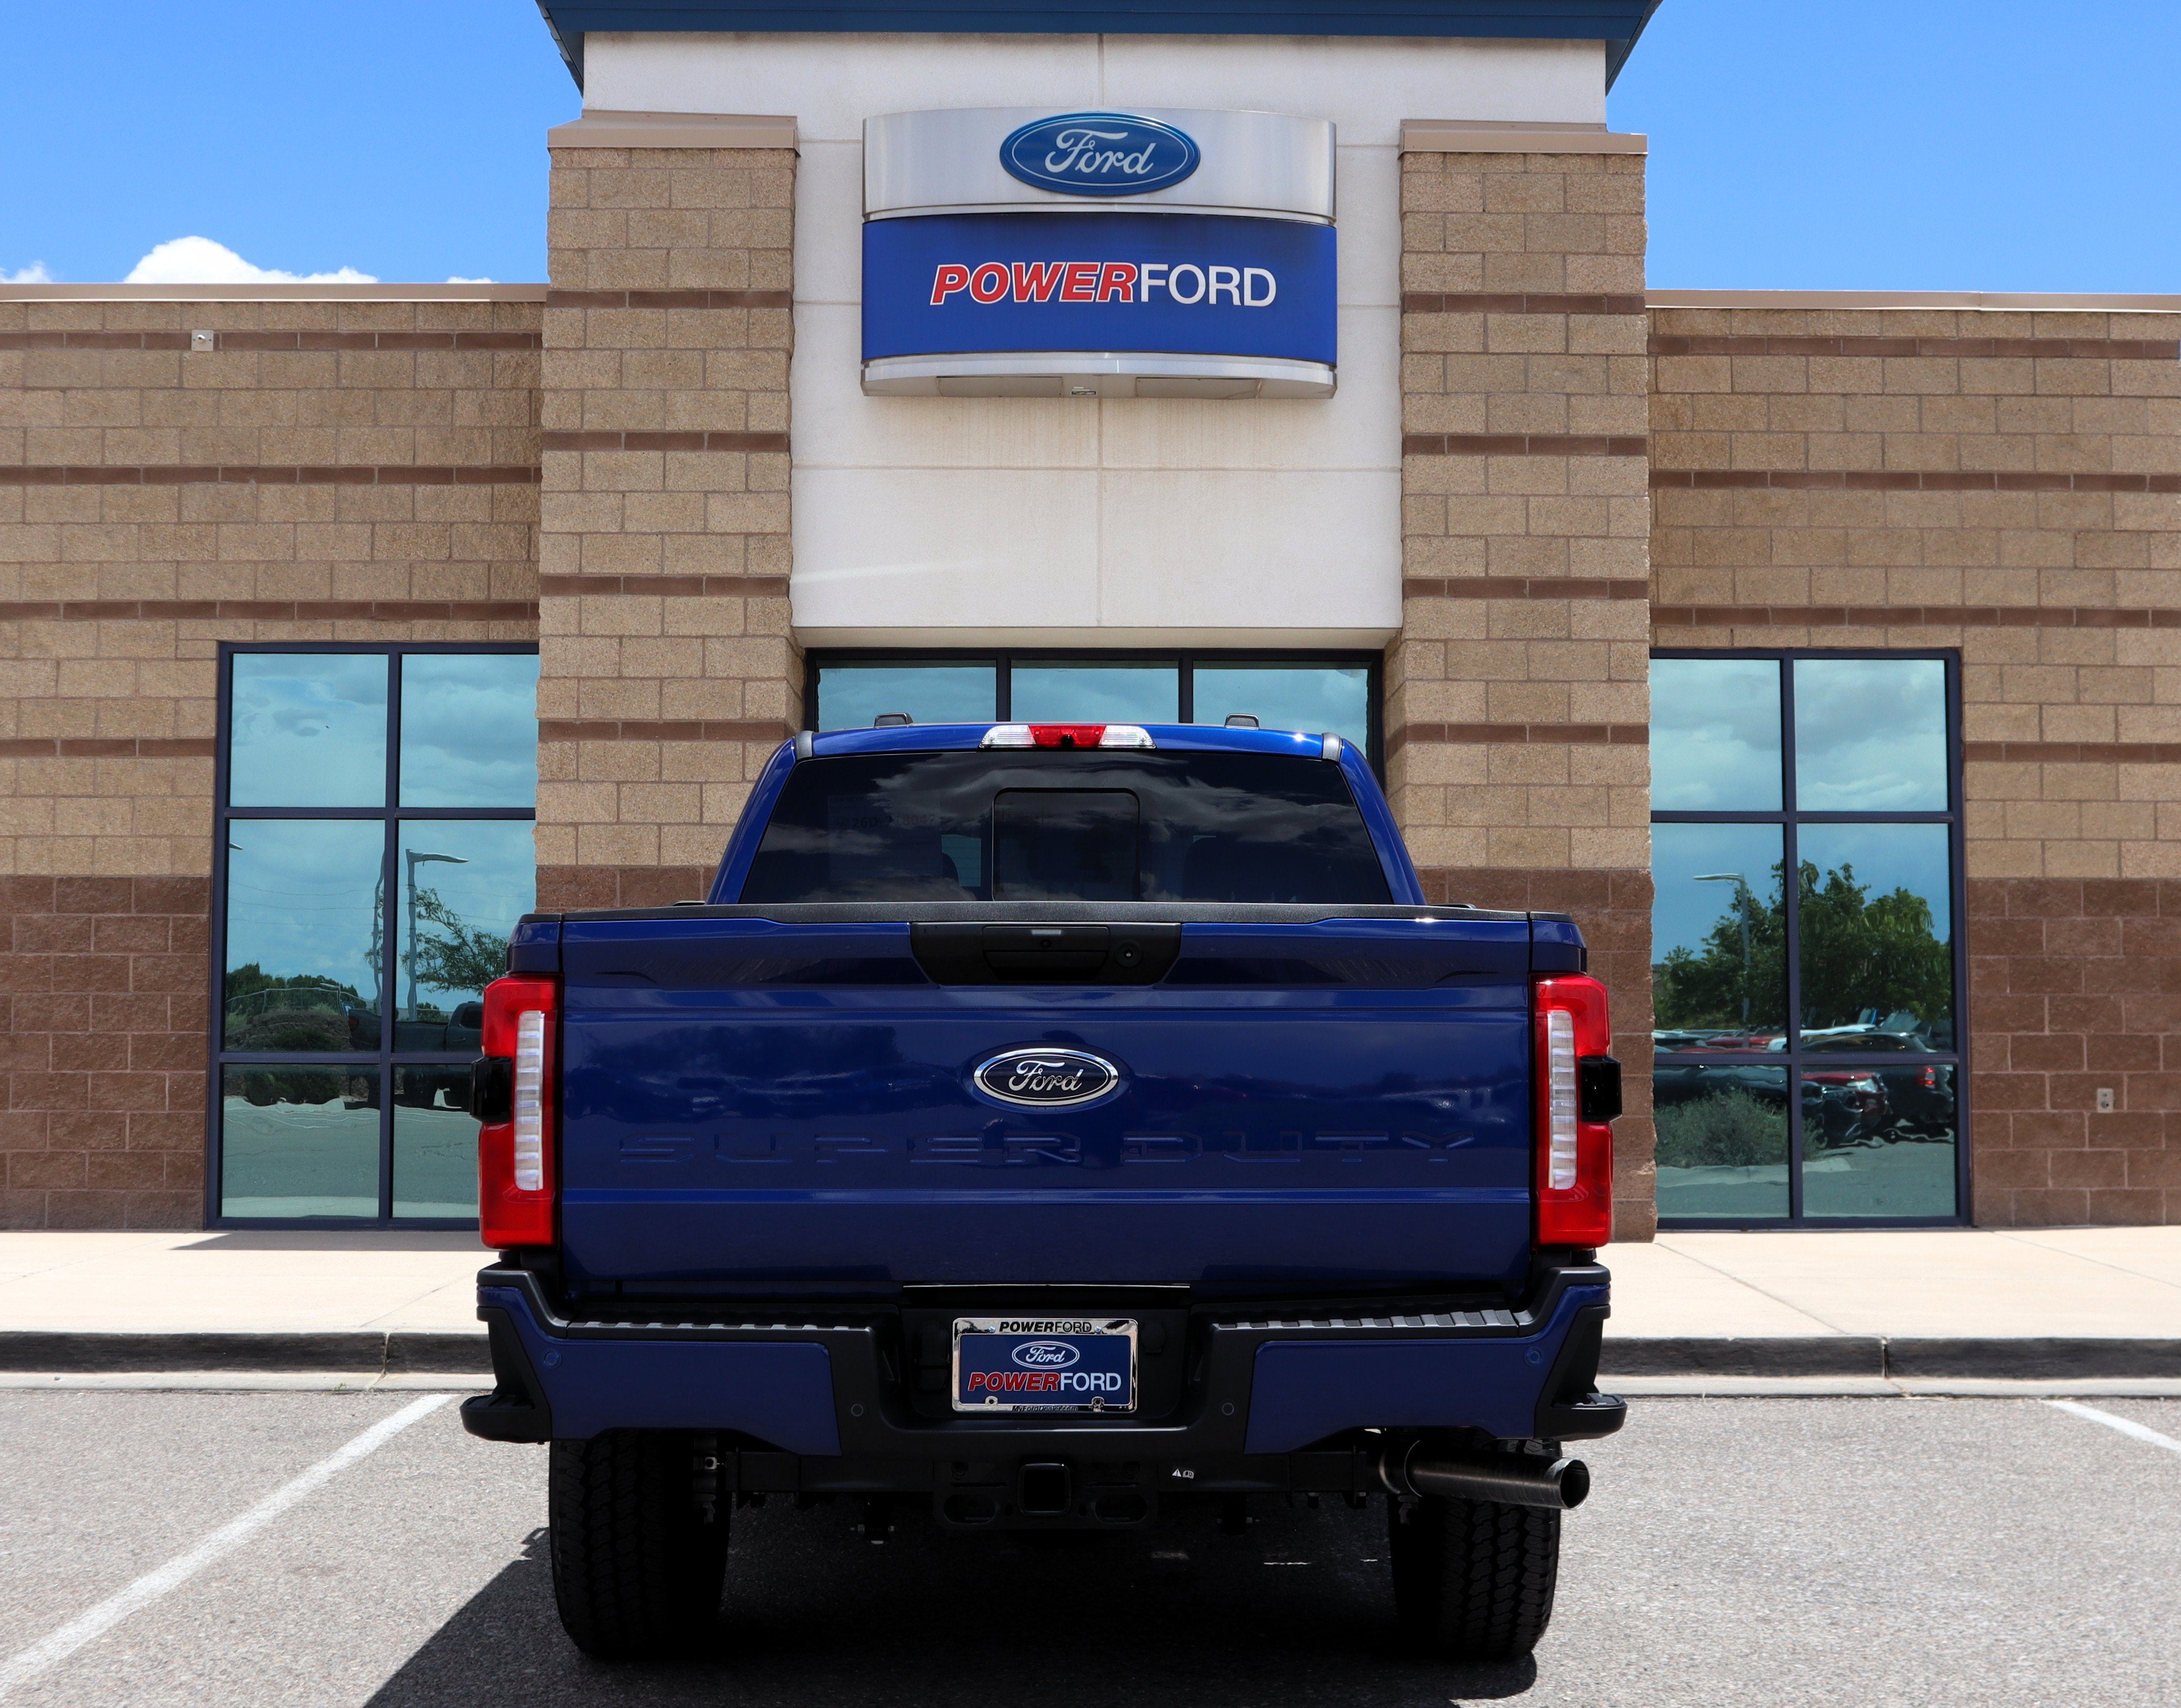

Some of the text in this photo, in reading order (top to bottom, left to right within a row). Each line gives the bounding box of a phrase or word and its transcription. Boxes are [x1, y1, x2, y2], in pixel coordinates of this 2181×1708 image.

[1044, 128, 1156, 175] Ford
[929, 261, 1277, 307] POWERFORD
[1008, 1060, 1084, 1091] Ford
[619, 1131, 1475, 1163] SUPER DUTY
[999, 1321, 1092, 1333] POWERFORD
[1026, 1346, 1065, 1363] Ford
[967, 1372, 1121, 1391] POWERFORD
